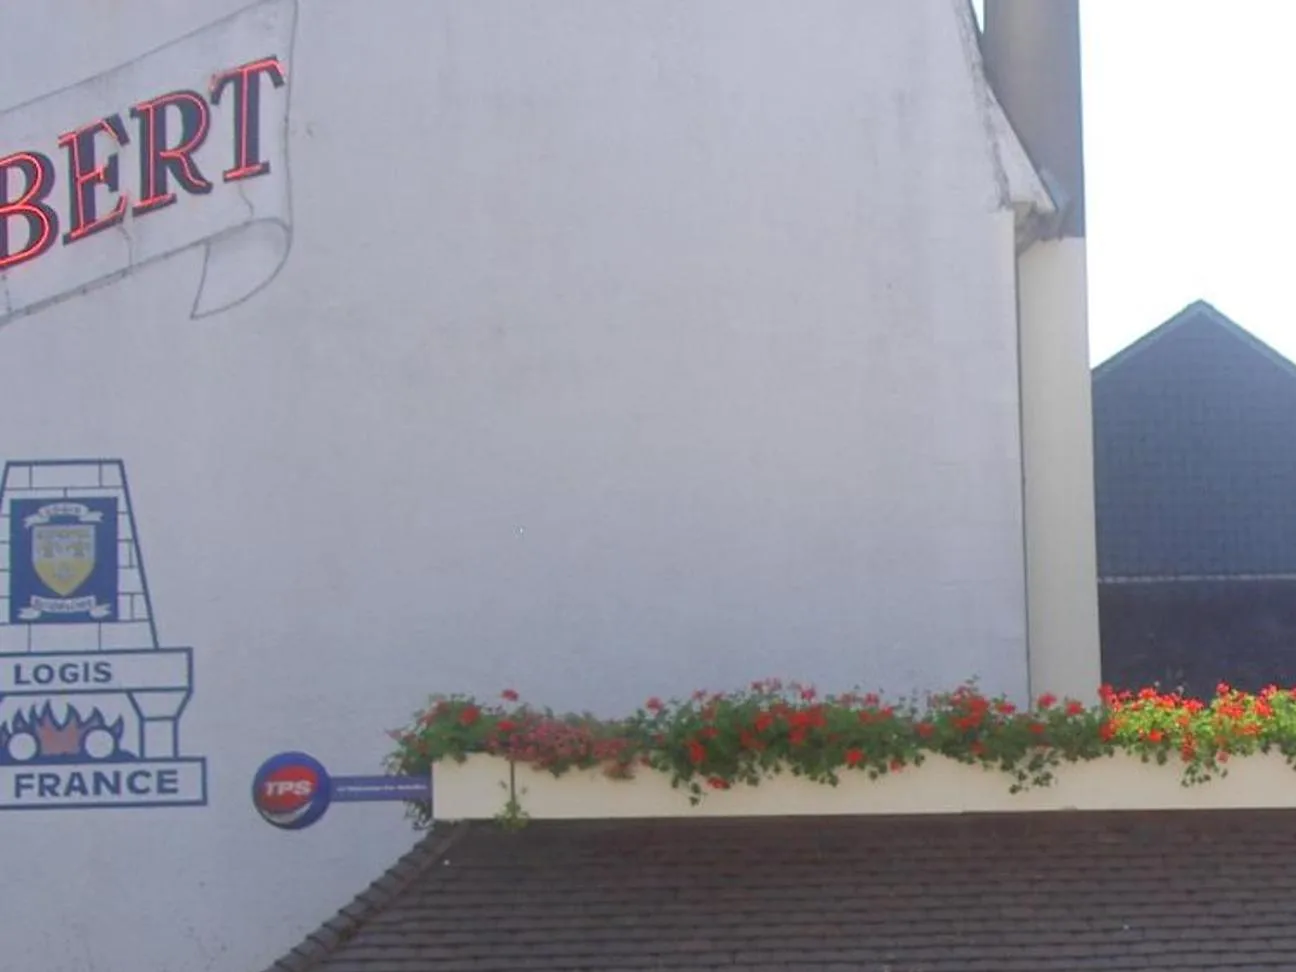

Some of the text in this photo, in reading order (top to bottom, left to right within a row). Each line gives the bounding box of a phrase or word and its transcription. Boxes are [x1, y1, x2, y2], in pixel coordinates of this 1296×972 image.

[0, 55, 285, 272] BERT
[13, 661, 113, 685] LOGIS
[14, 769, 179, 799] FRANCE
[264, 780, 312, 796] TPS
